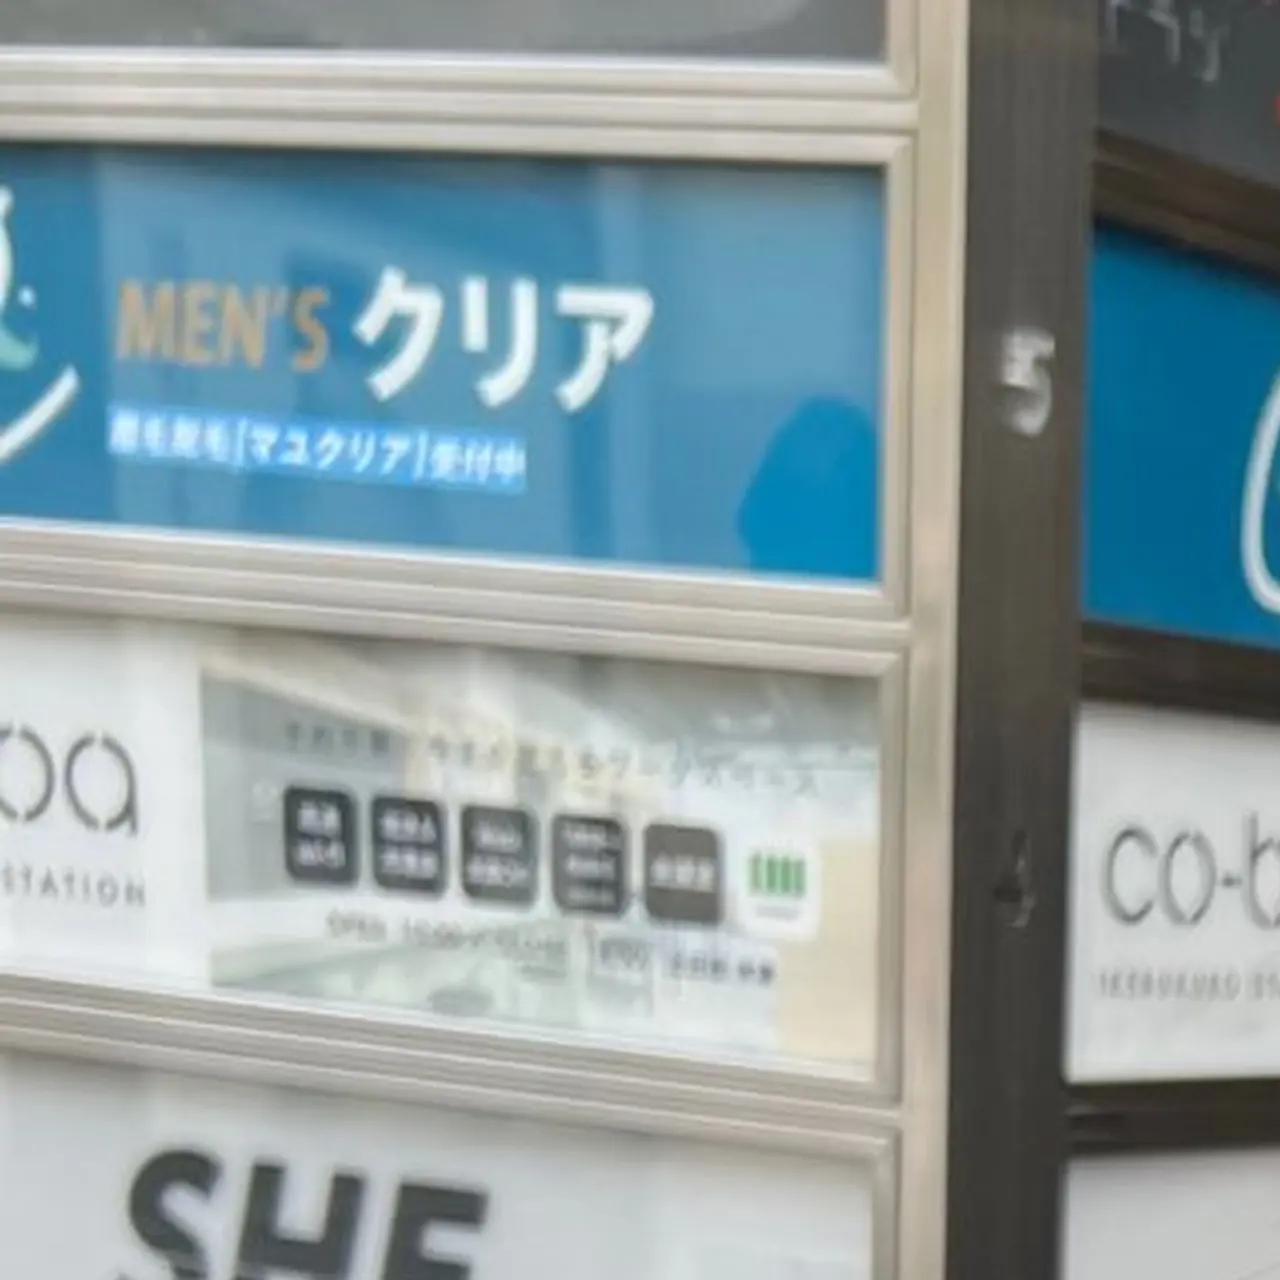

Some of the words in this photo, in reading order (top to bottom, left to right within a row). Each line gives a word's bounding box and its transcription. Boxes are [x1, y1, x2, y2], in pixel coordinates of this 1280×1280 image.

[114, 280, 332, 372] MEN'S
[352, 265, 656, 412] クリア
[1001, 326, 1055, 437] 5
